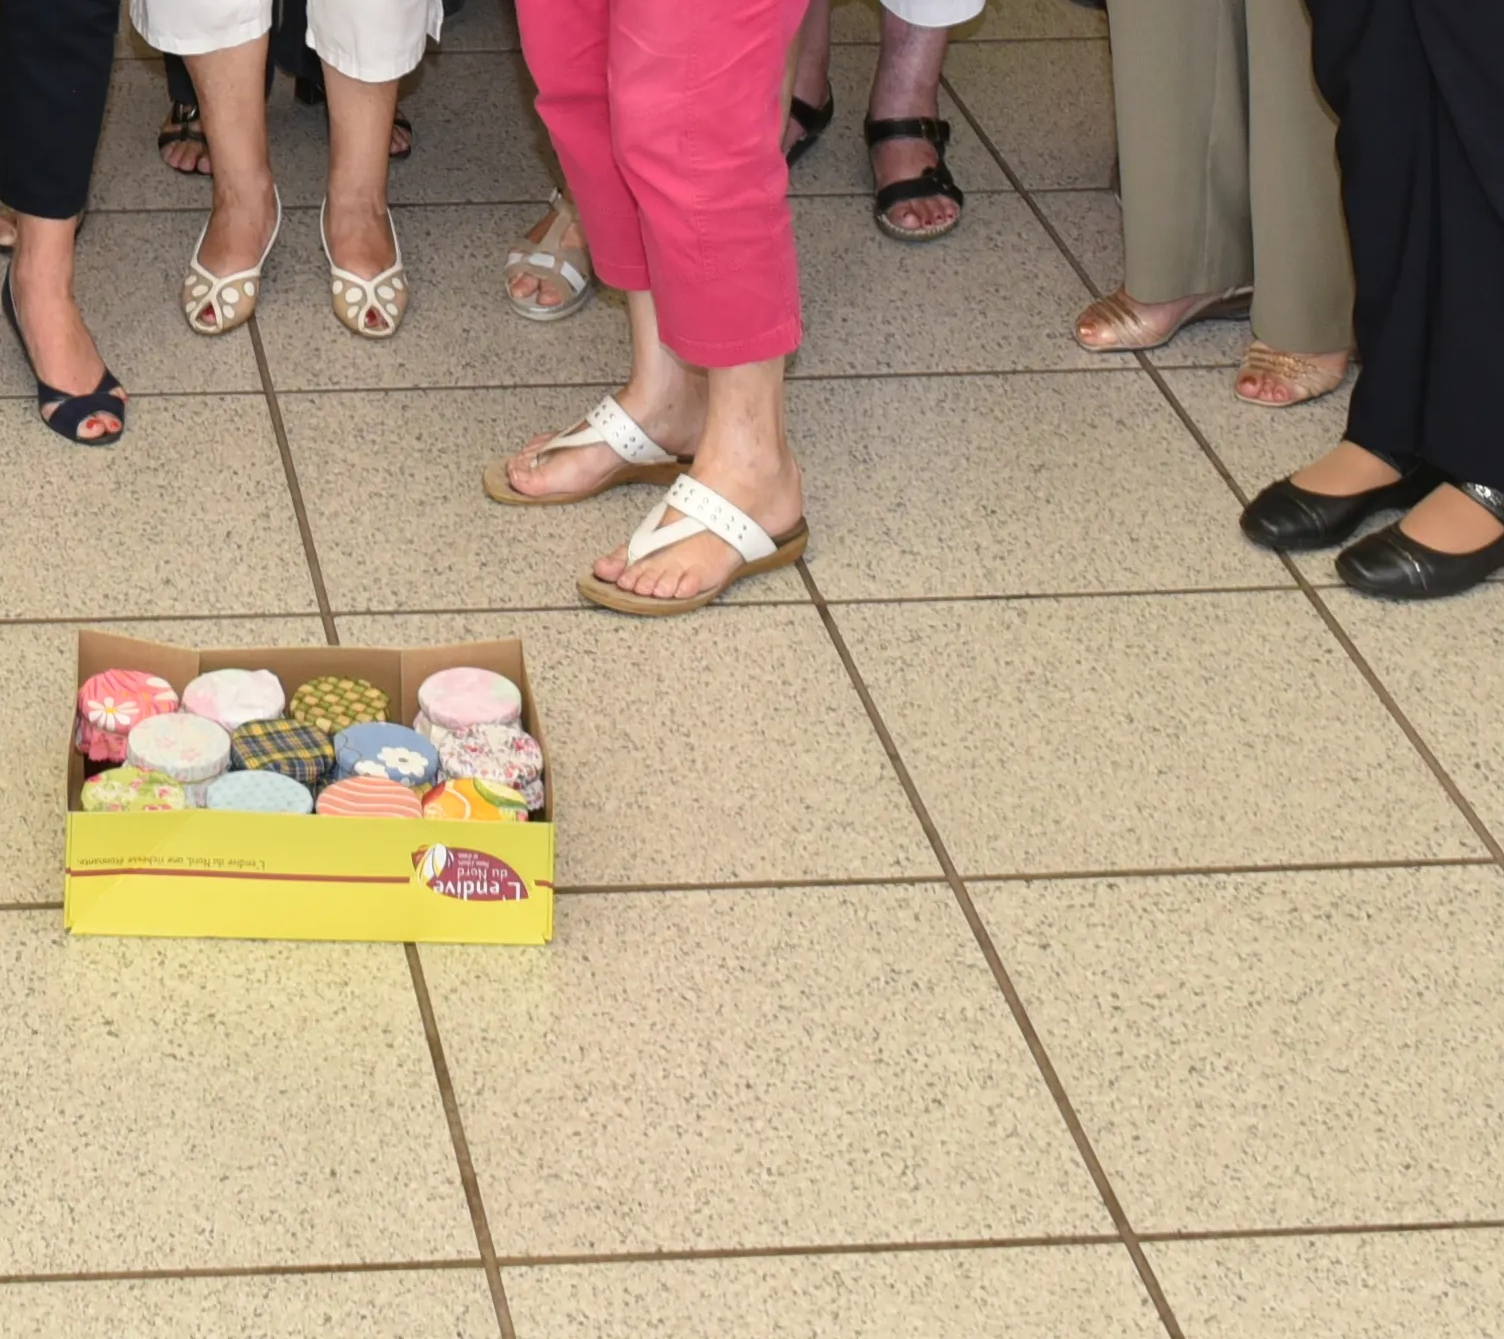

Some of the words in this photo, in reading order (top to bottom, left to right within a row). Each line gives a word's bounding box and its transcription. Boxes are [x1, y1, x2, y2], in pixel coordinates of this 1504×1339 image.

[457, 867, 488, 880] Nord
[492, 868, 508, 881] du
[433, 880, 521, 902] L'endive
